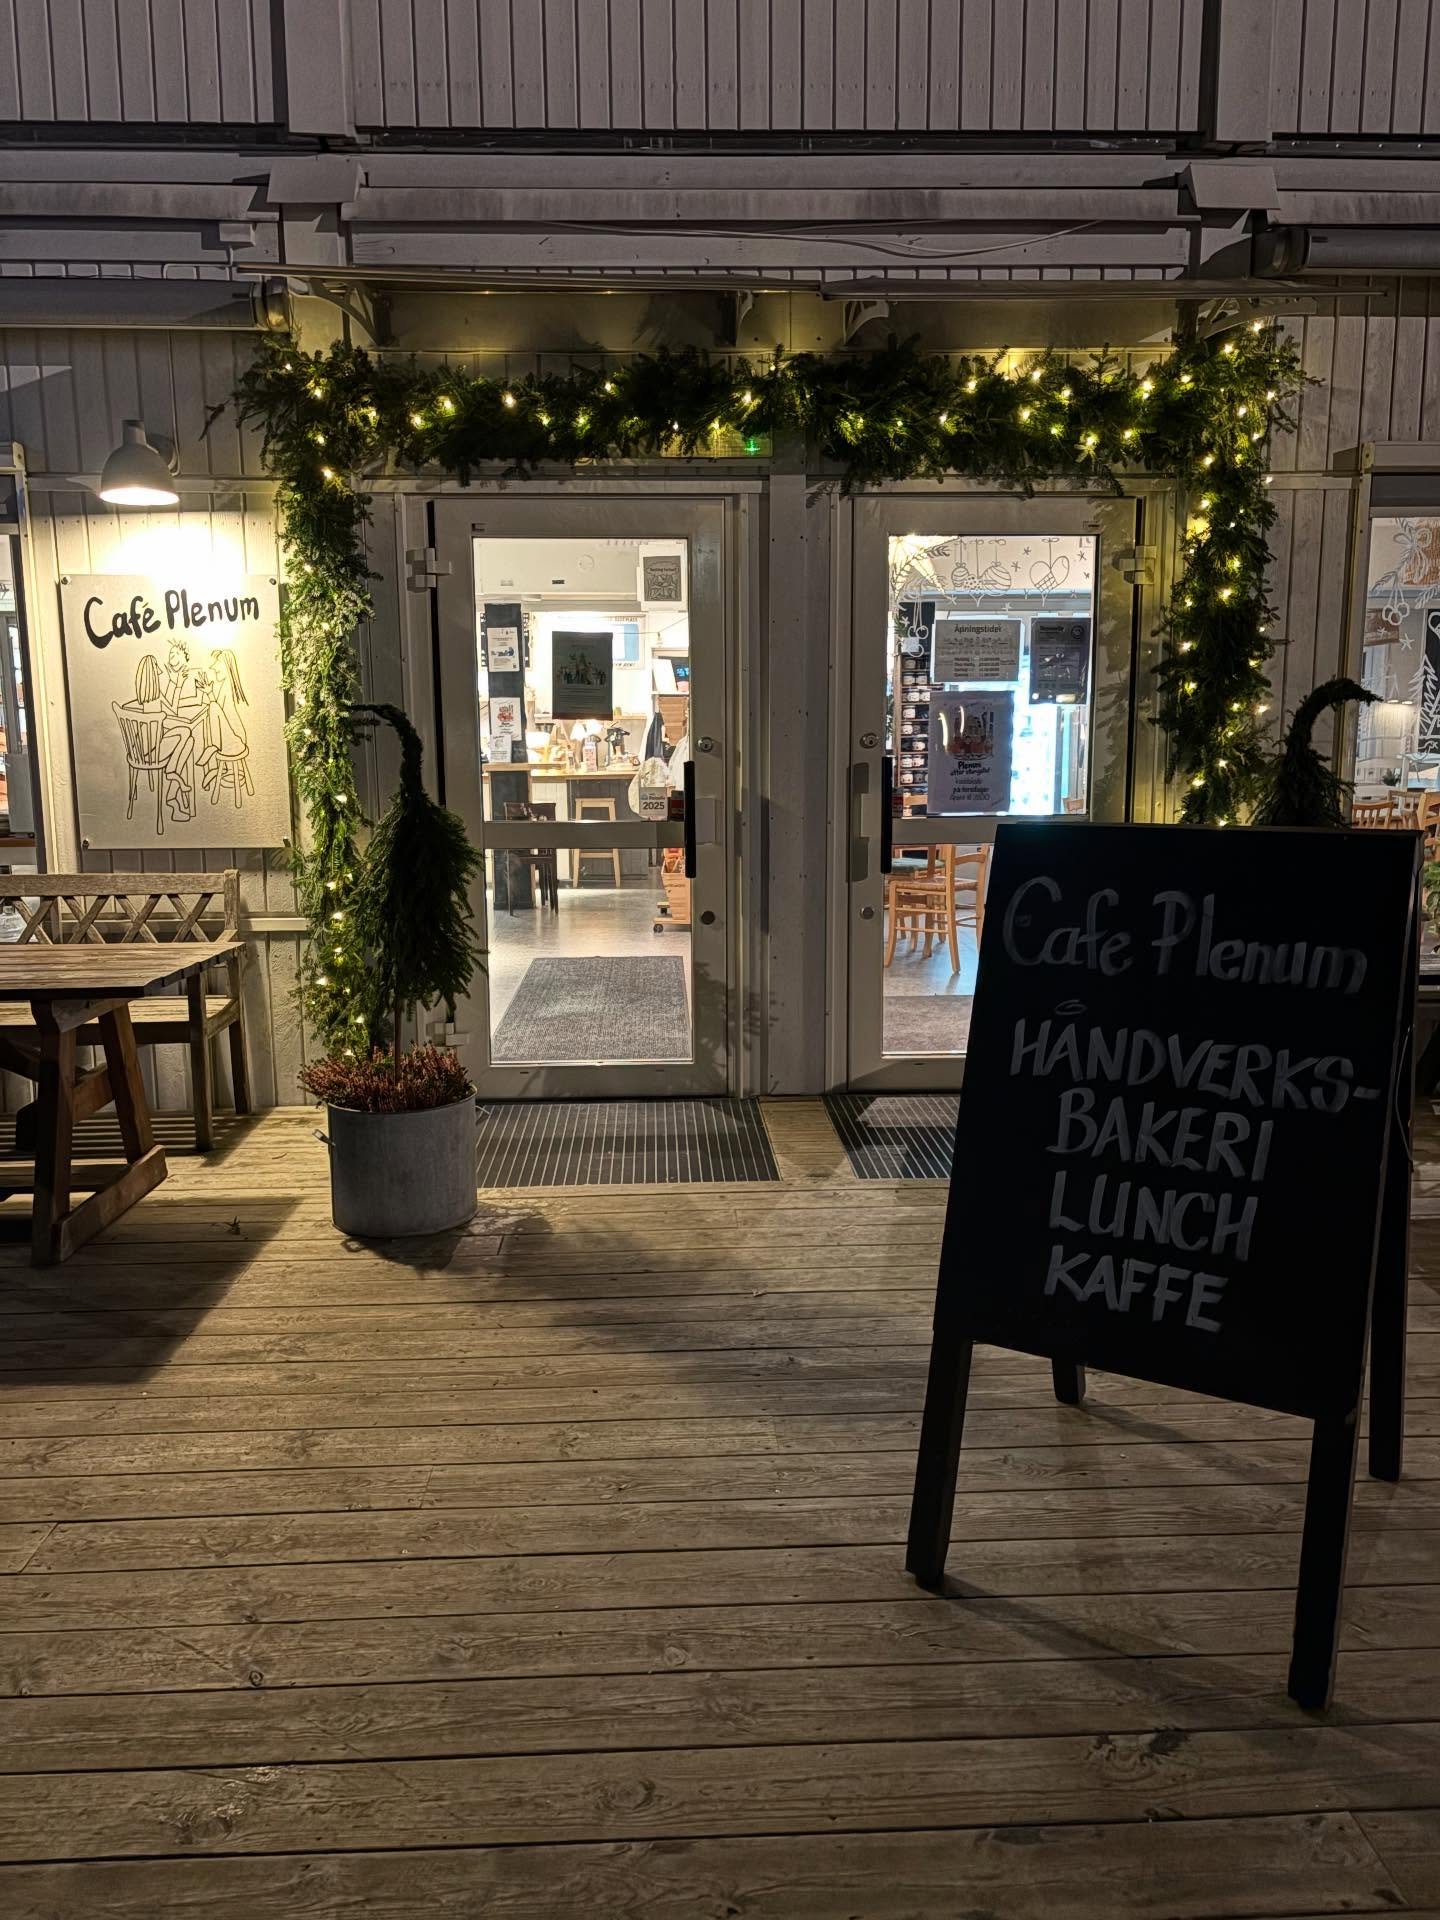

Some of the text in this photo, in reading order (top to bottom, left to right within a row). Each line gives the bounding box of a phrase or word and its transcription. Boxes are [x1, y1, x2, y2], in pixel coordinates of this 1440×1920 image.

[84, 588, 259, 649] Café Plenum
[954, 623, 1002, 635] Åpningstider
[643, 801, 665, 810] 2025
[1003, 876, 1368, 994] Cafe Plenum
[1009, 999, 1382, 1113] HÅNDVERKS-
[1045, 1087, 1275, 1182] BAKERI
[1048, 1170, 1259, 1262] LUNCH
[1043, 1244, 1230, 1333] KAFFE
